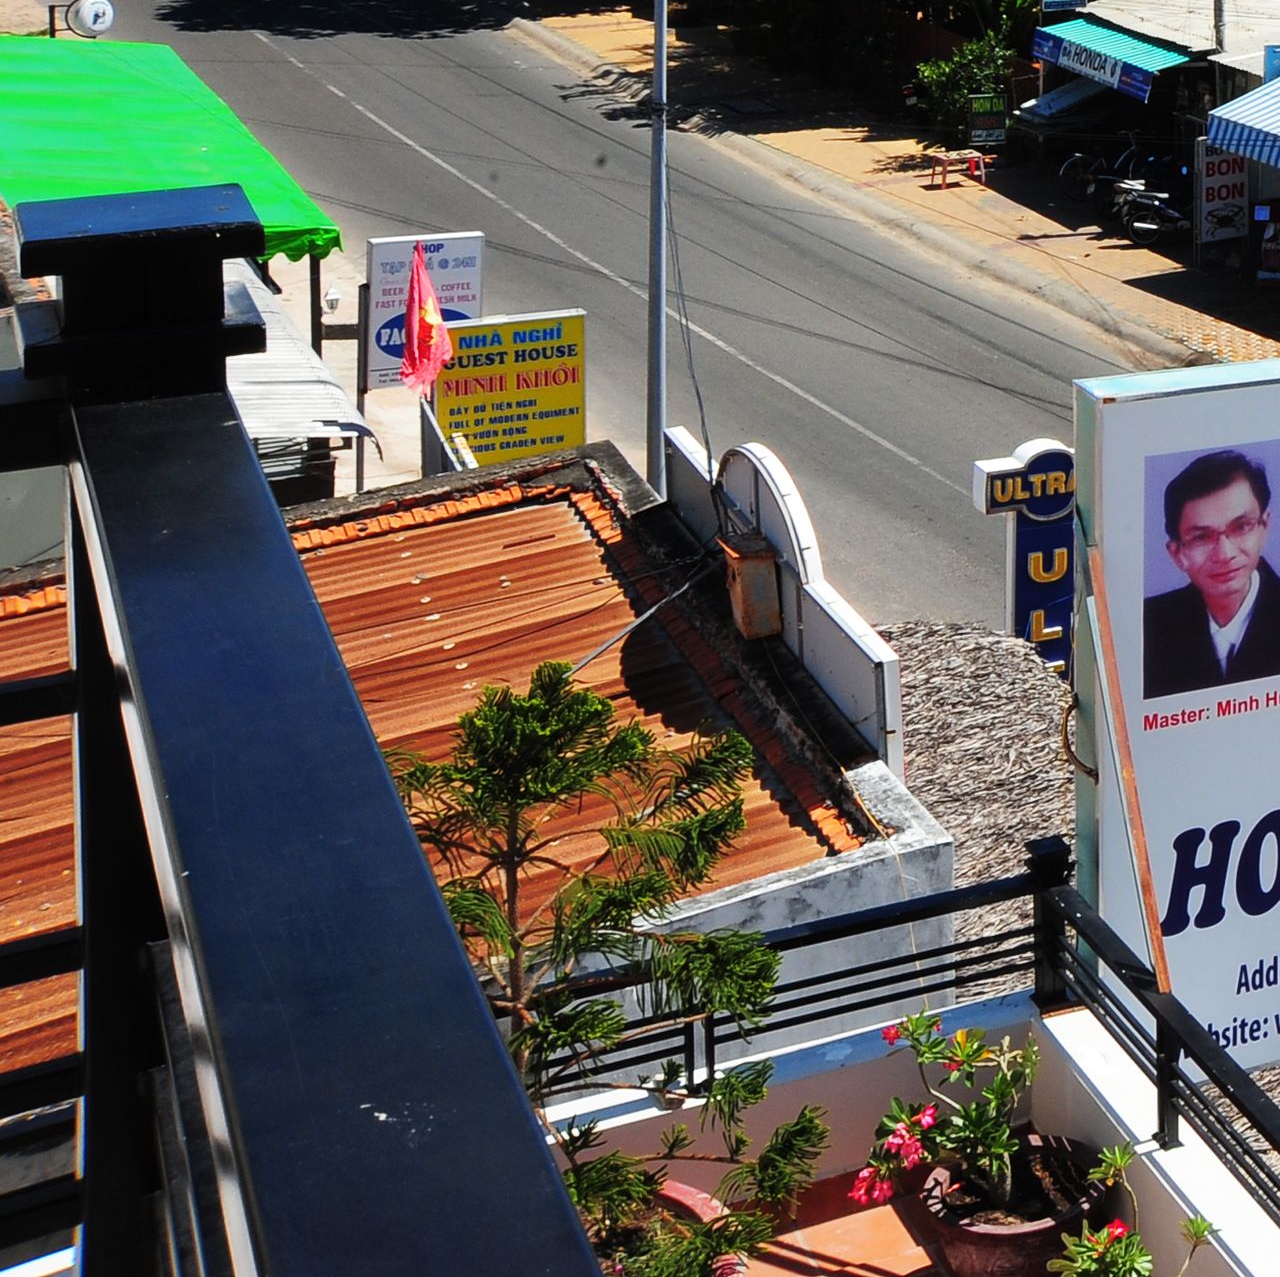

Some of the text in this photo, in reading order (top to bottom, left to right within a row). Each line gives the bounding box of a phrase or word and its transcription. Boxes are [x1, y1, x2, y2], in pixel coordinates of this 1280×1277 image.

[1072, 46, 1108, 75] HONDA
[1205, 157, 1245, 178] BON
[1205, 182, 1245, 203] BON
[382, 282, 472, 297] BEER COFFEE
[375, 299, 397, 310] FAST
[458, 329, 503, 350] NHÀ
[443, 344, 578, 371] GUEST HOUSE
[443, 373, 508, 398] MINH
[449, 419, 470, 430] FULL
[474, 418, 485, 427] OF
[489, 413, 529, 425] MODERN
[540, 435, 565, 445] VIEW
[1143, 706, 1211, 731] Master:
[1216, 696, 1259, 718] Minh
[1207, 1018, 1269, 1050] bsite:
